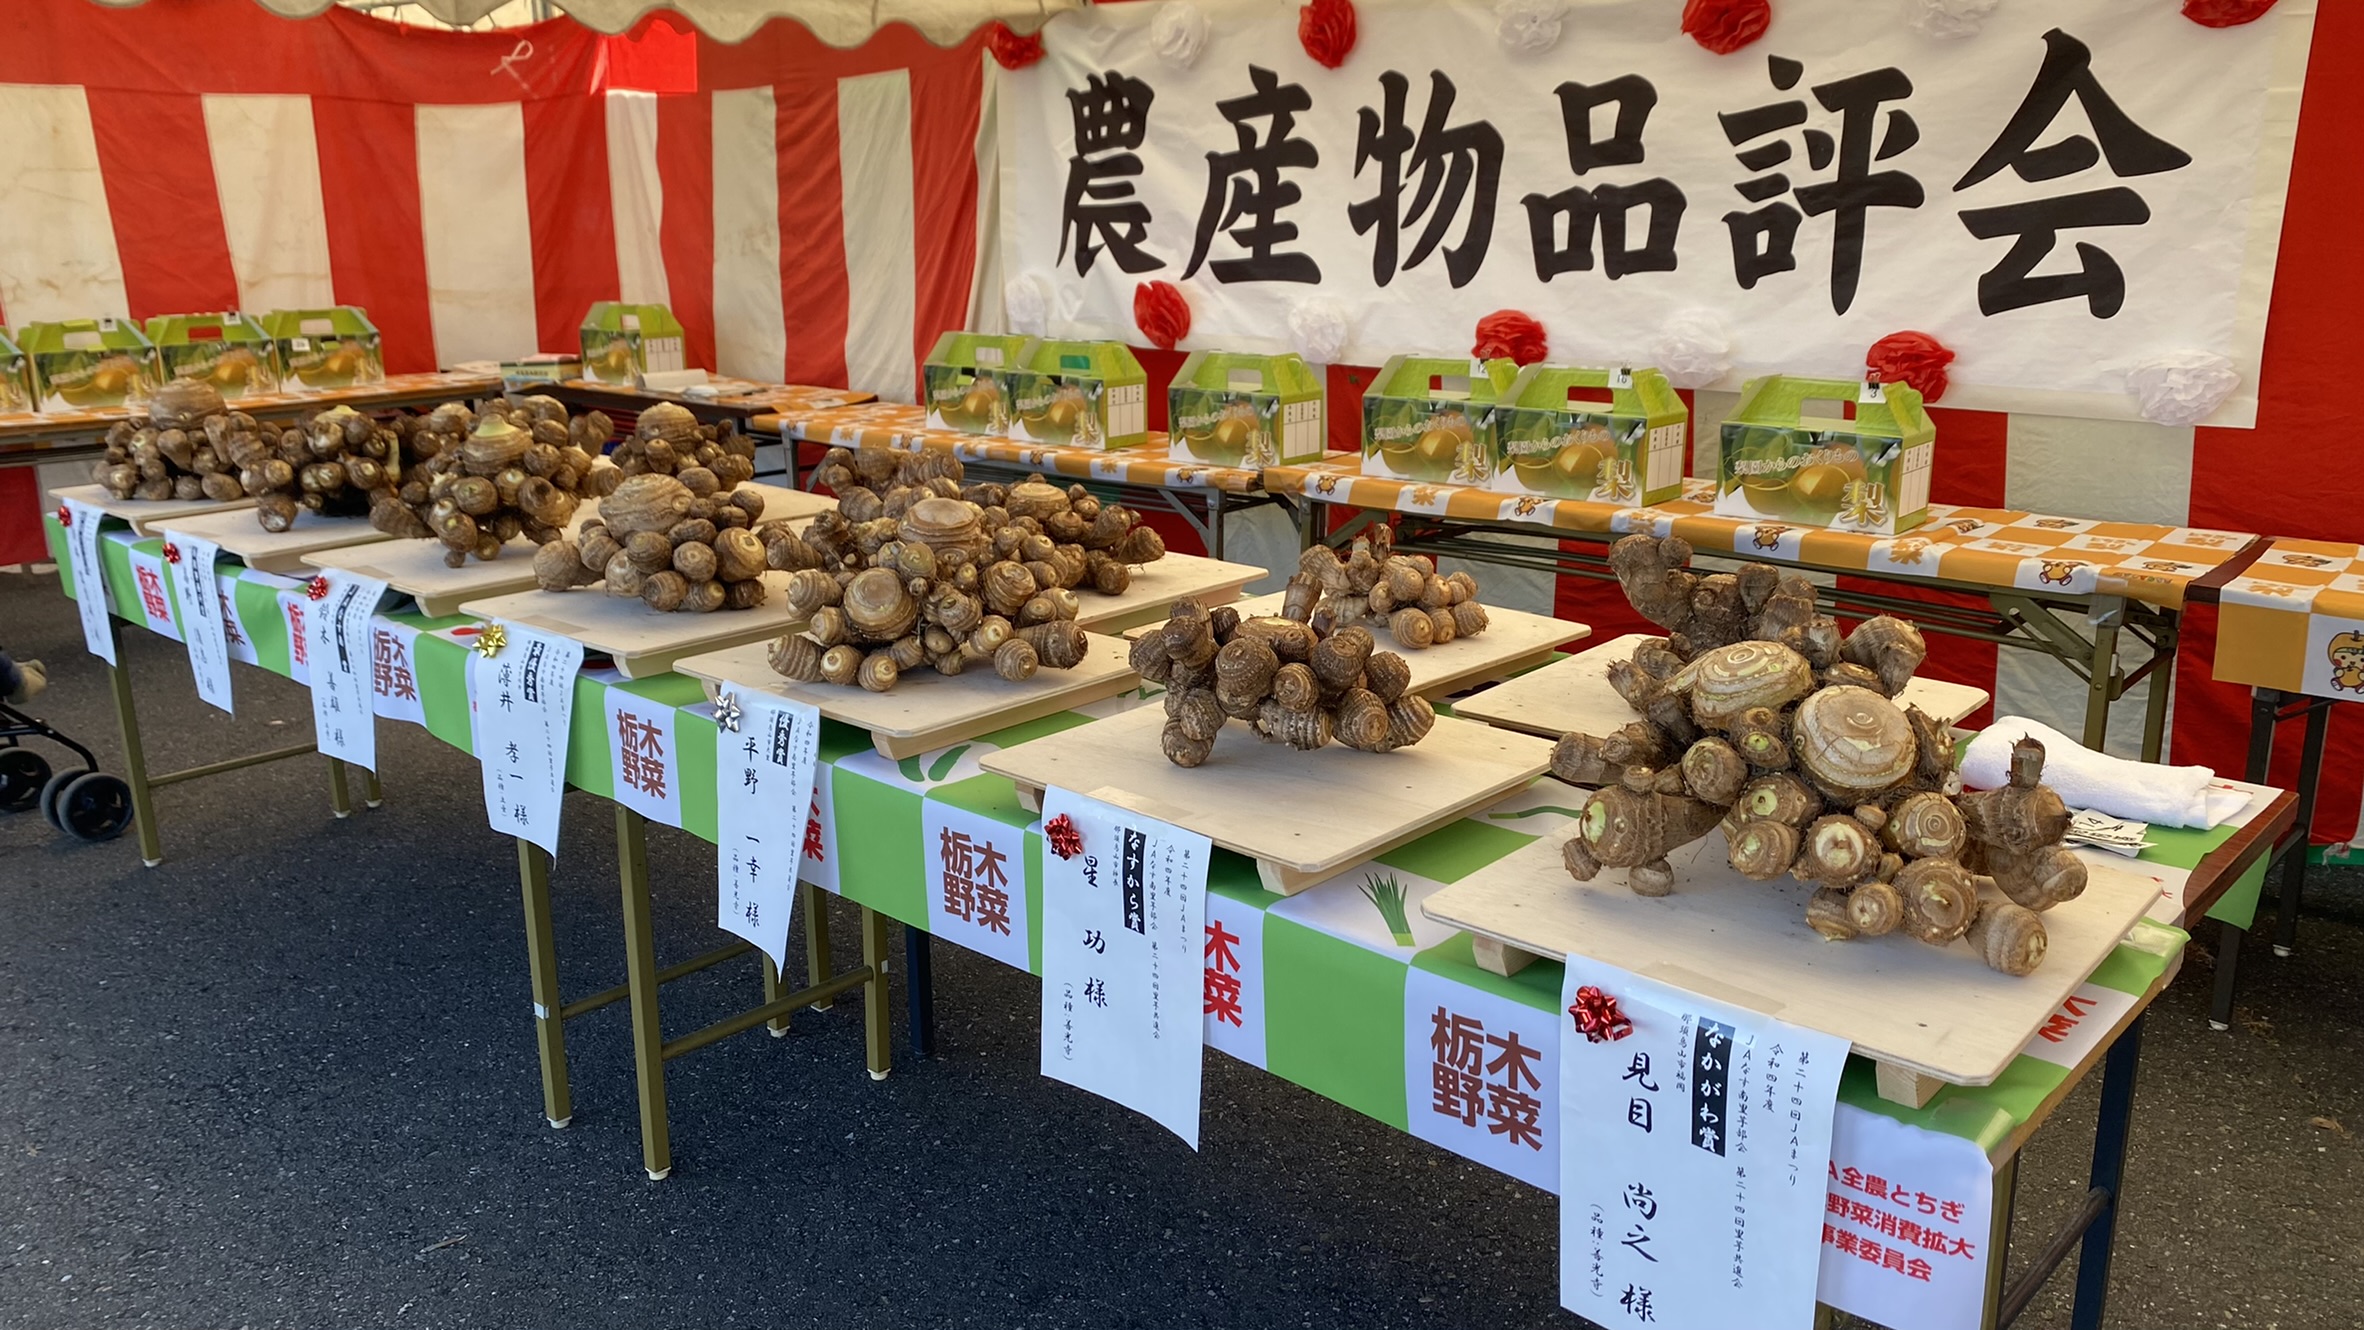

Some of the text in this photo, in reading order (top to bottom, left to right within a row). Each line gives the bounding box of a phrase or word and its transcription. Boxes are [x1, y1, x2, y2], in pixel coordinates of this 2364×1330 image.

[1055, 30, 2191, 318] 農産物品評会
[1453, 441, 1489, 482] 梨
[1595, 455, 1636, 501] 梨
[1734, 448, 1860, 475] 梨園からのおくりもの
[1839, 479, 1888, 527] 梨
[616, 708, 664, 759] 栃木
[621, 746, 667, 800] 野菜
[514, 804, 530, 826] 様
[742, 736, 761, 928] 平野 一幸 様
[940, 826, 1009, 887] 栃木
[1126, 824, 1142, 933] なすから賞
[1164, 844, 1176, 898] 令和四年度
[943, 870, 1011, 937] 野菜
[1082, 856, 1109, 1008] 星 功 様
[1179, 849, 1192, 953] 第二十四回JAまつり
[1430, 1005, 1542, 1092] 栃木
[1676, 1013, 1693, 1093] 那須烏山市福岡
[1699, 1023, 1726, 1153] なかがわ賞
[1763, 1044, 1784, 1114] 令和四年度
[1432, 1061, 1544, 1152] 野菜
[1788, 1050, 1810, 1187] 第二十四回JAまつり
[1619, 1052, 1660, 1323] 見目 尚之 様
[1731, 1035, 1755, 1289] JAなす南里芋部会 第二十四回里芋共進会
